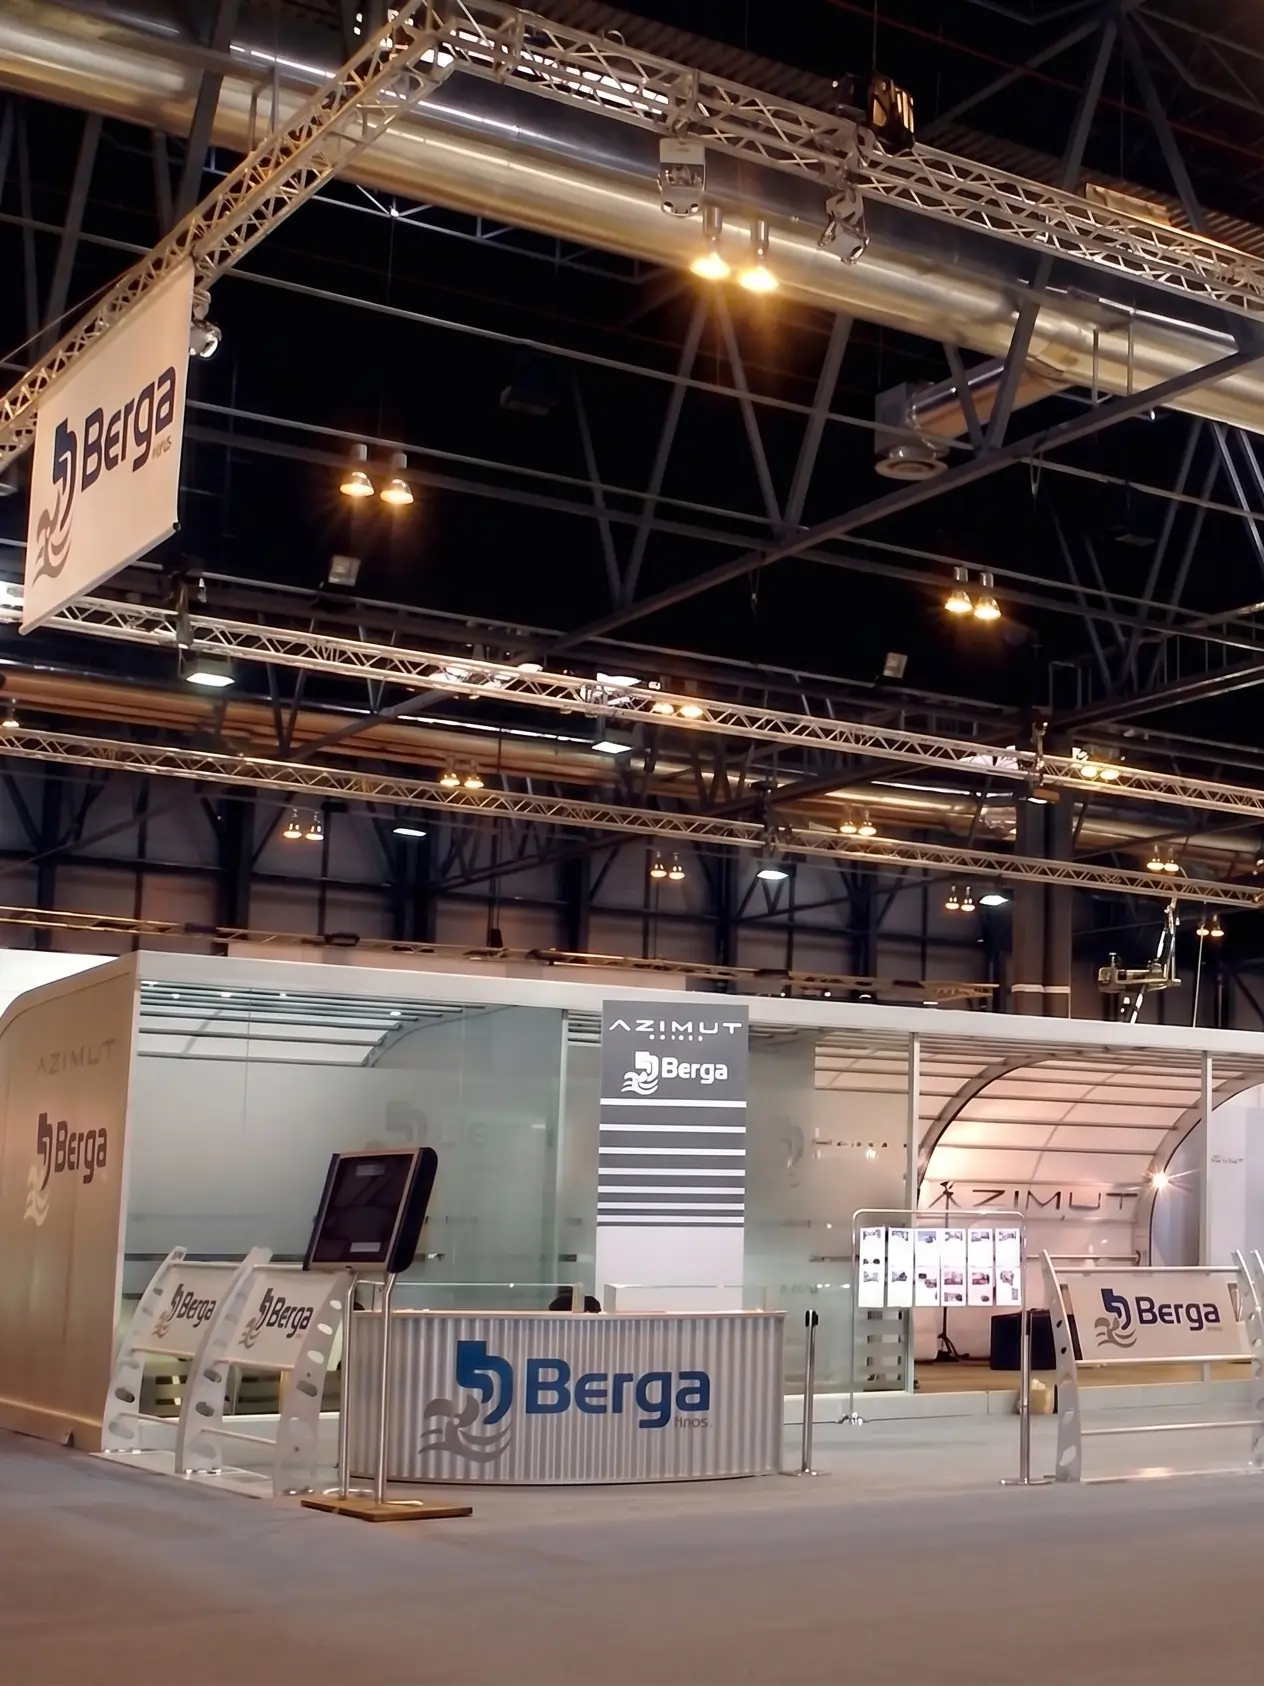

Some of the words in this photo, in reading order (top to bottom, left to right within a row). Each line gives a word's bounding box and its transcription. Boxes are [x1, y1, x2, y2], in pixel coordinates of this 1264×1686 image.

[81, 366, 176, 492] Berga
[609, 1019, 742, 1034] AZIMUT
[661, 1057, 728, 1084] Berga
[54, 1120, 107, 1184] Berga
[928, 1189, 1138, 1210] AZIMUT
[176, 1292, 216, 1328] Berga
[266, 1297, 313, 1338] Berga
[1135, 1297, 1221, 1331] Berga
[525, 1358, 710, 1428] Berga
